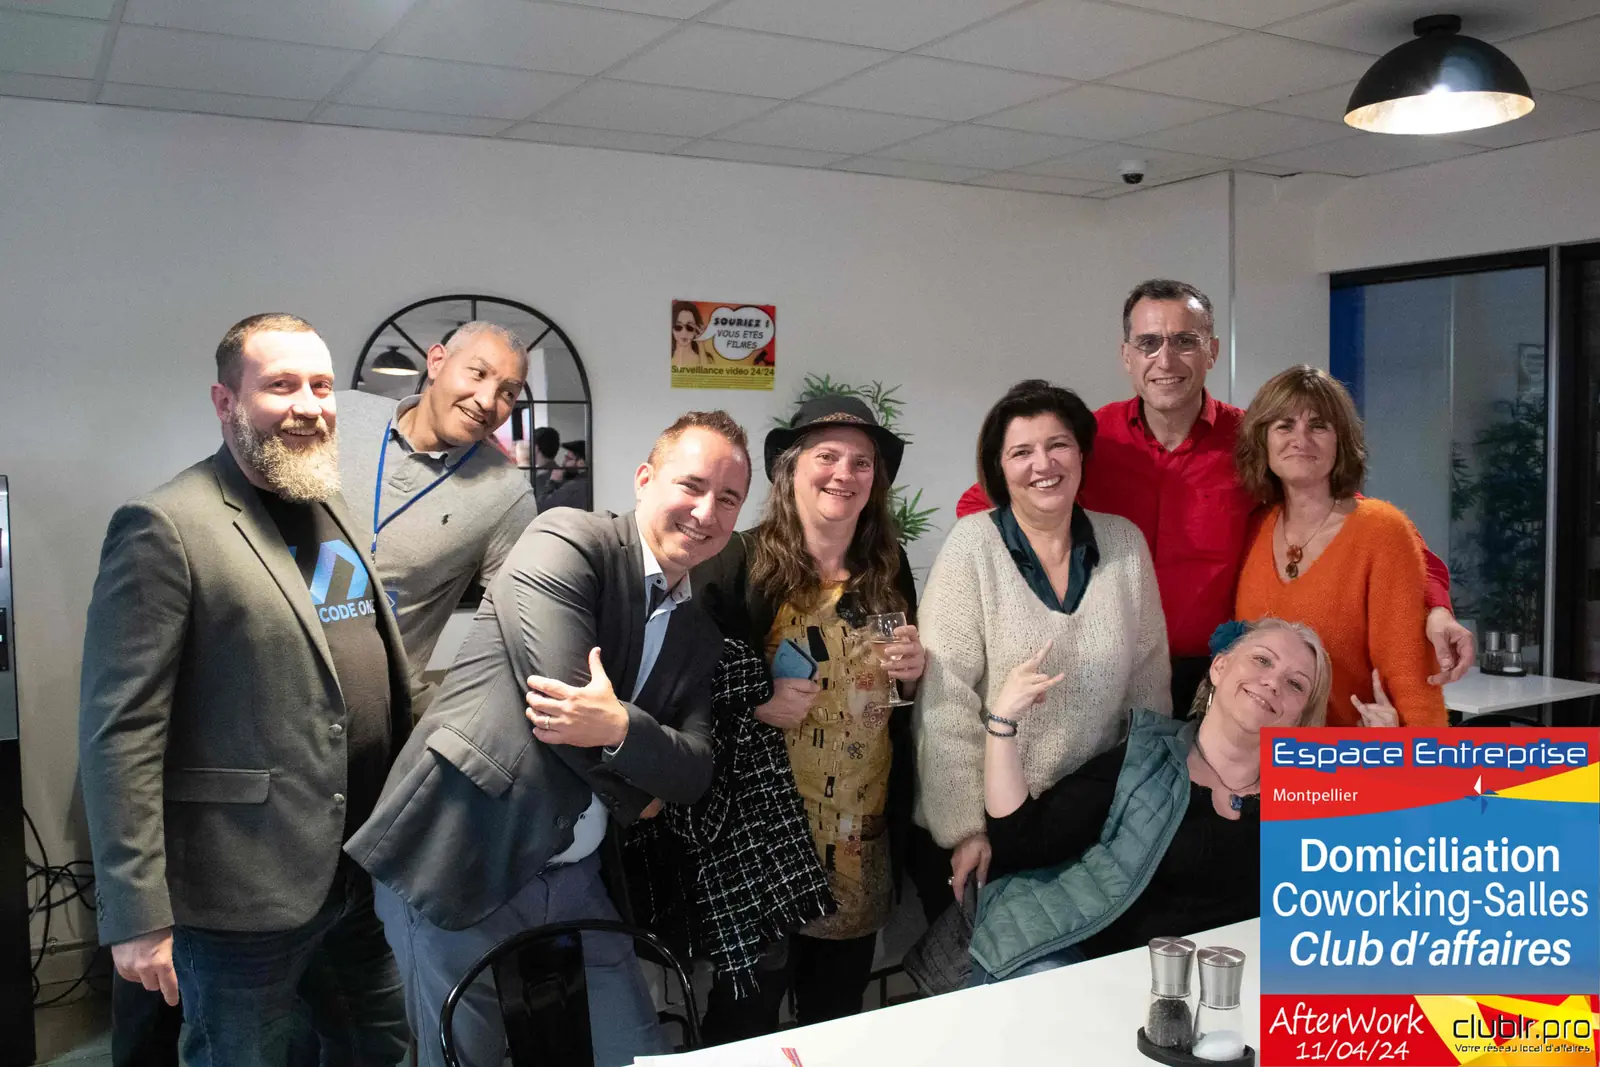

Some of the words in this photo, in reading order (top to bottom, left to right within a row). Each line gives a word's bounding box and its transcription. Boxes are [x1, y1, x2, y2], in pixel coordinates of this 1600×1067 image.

[714, 317, 761, 328] SOURIEZ
[717, 329, 740, 339] VOUS
[671, 365, 724, 376] Surveillance
[750, 367, 775, 377] 24/24
[319, 602, 359, 623] CODE
